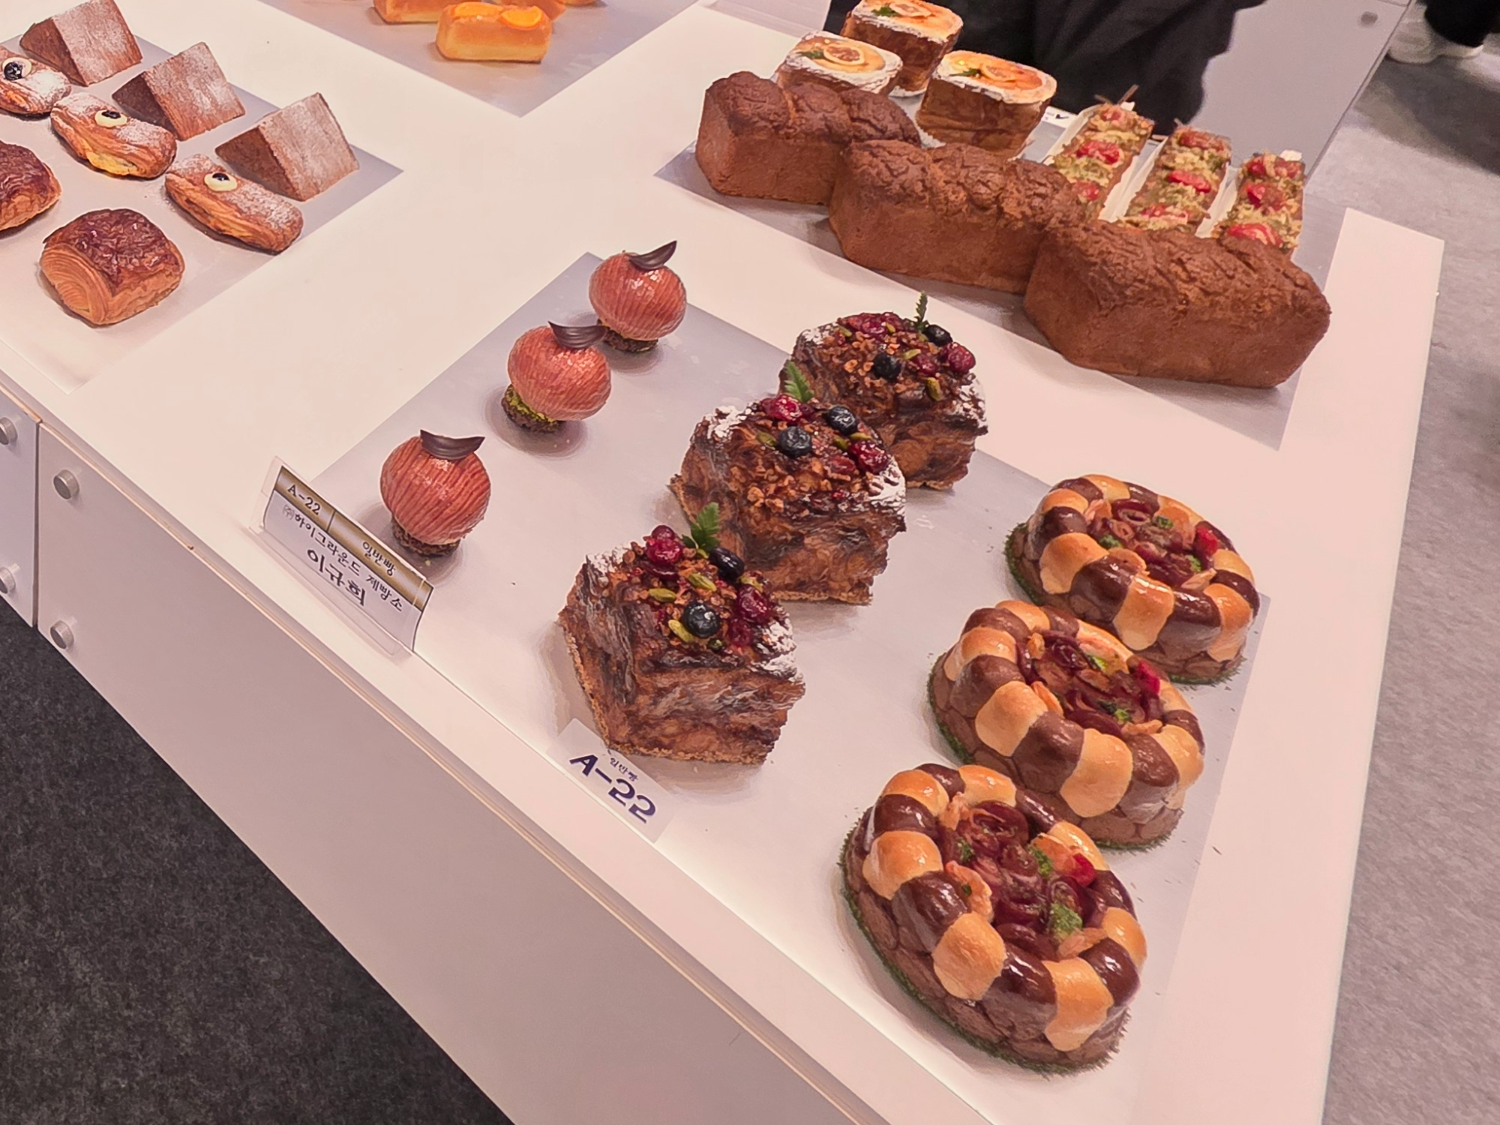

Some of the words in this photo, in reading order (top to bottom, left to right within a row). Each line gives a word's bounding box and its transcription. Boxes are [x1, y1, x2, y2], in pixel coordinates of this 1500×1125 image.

[287, 484, 321, 516] A-22
[362, 541, 396, 576] 일반빵
[307, 549, 366, 607] 이규희
[366, 575, 403, 612] 제빵소
[568, 754, 656, 824] A-22
